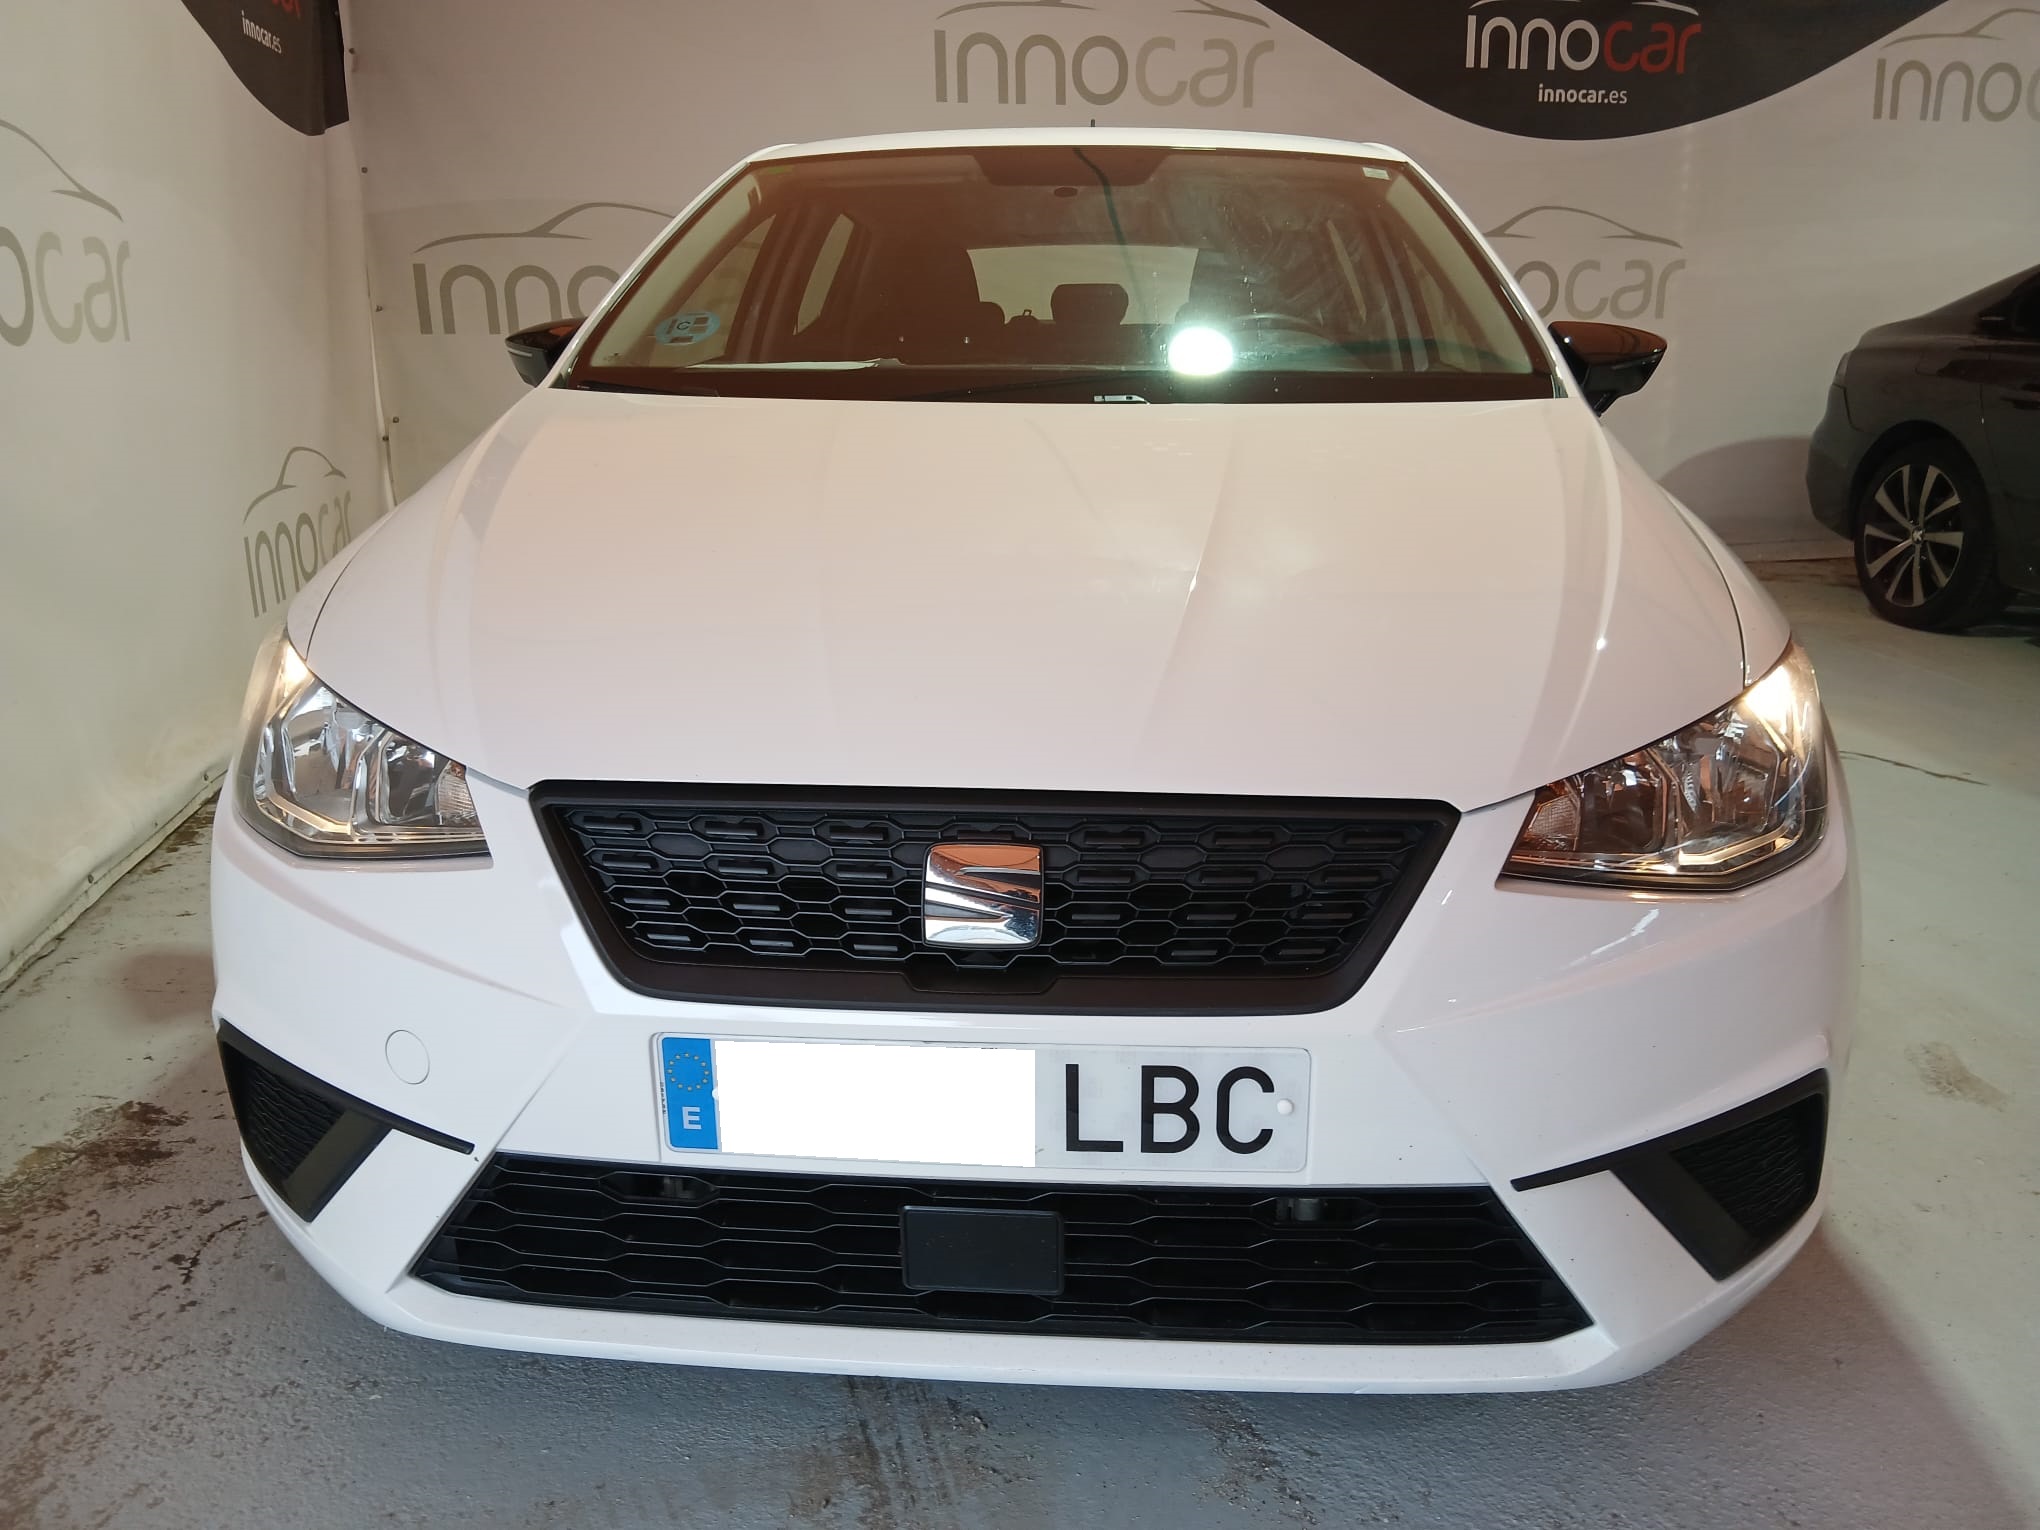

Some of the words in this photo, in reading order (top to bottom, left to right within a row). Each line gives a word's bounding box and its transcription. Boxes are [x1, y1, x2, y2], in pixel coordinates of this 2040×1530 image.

[241, 8, 282, 55] innocar.es
[1465, 14, 1703, 75] innocar
[933, 29, 1275, 108] innocar
[1537, 83, 1628, 105] innocar.es
[1872, 58, 2040, 122] inno
[681, 1105, 703, 1131] E
[1064, 1063, 1275, 1155] LBC
